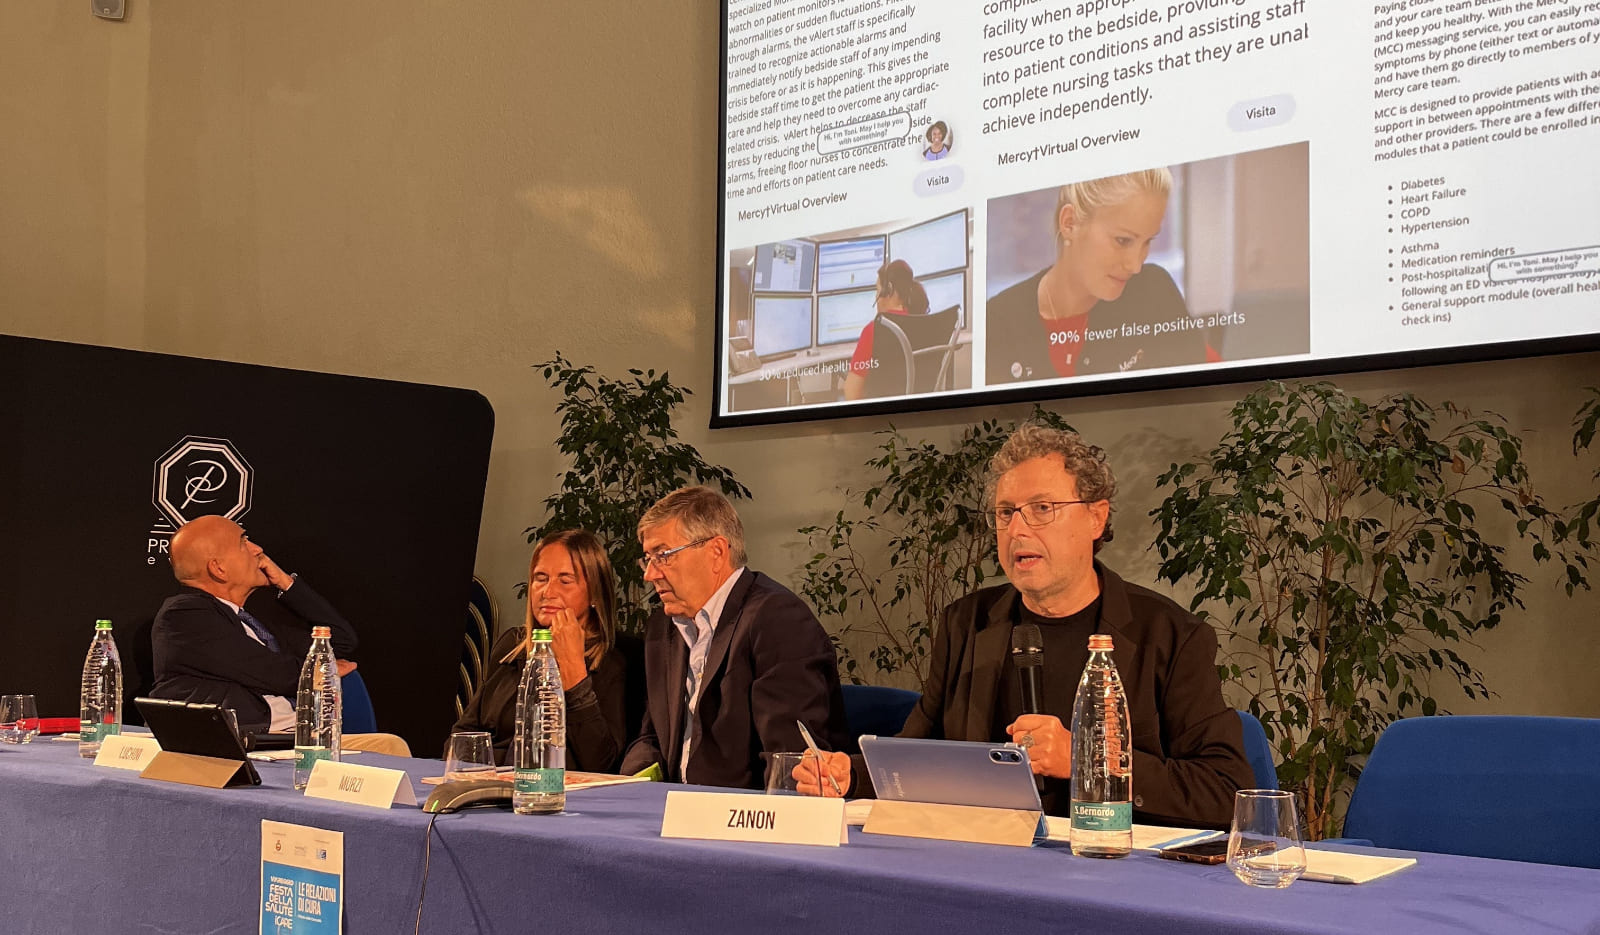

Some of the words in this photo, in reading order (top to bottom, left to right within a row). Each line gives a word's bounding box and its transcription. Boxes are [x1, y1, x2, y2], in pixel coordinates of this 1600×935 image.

[983, 17, 1027, 39] facility
[1031, 0, 1071, 26] when
[983, 38, 1044, 63] resource
[1049, 33, 1063, 46] to
[1068, 25, 1092, 42] the
[1097, 8, 1161, 35] bedside,
[1374, 42, 1403, 57] (MCC)
[1405, 31, 1459, 50] messaging
[1462, 23, 1501, 38] service,
[1504, 18, 1524, 32] you
[1527, 13, 1546, 24] can
[1549, 5, 1581, 19] easily
[728, 62, 756, 78] trained
[758, 62, 766, 71] to
[768, 51, 807, 68] recognize
[810, 37, 854, 57] actionable
[856, 29, 886, 44] alarms
[889, 21, 906, 36] and
[983, 70, 1009, 86] into
[1014, 55, 1064, 83] patient
[1069, 37, 1148, 66] conditions
[1153, 24, 1182, 47] and
[1188, 10, 1260, 38] assisting
[1266, 0, 1305, 20] staff
[728, 73, 777, 93] immediately
[778, 66, 802, 80] notify
[804, 57, 837, 74] bedside
[840, 50, 859, 65] staff
[861, 47, 870, 59] of
[872, 45, 889, 56] any
[891, 31, 940, 51] impending
[1374, 72, 1392, 84] and
[1395, 69, 1419, 80] have
[1421, 63, 1448, 75] them
[1451, 60, 1464, 71] go
[1466, 50, 1505, 65] directly
[1508, 48, 1520, 57] to
[1522, 37, 1576, 54] members
[1578, 31, 1591, 43] of
[728, 97, 747, 109] crisis
[749, 90, 775, 103] before
[777, 87, 786, 96] or
[789, 84, 798, 93] as
[800, 81, 805, 90] it
[808, 80, 814, 88] is
[816, 67, 864, 86] happening.
[867, 61, 885, 73] This
[887, 55, 910, 71] gives
[913, 51, 928, 62] the
[982, 85, 1048, 110] complete
[1052, 71, 1108, 94] nursing
[1113, 60, 1152, 80] tasks
[1158, 51, 1190, 71] that
[1194, 43, 1232, 63] they
[1236, 36, 1263, 54] are
[728, 108, 758, 123] bedside
[760, 101, 779, 116] staff
[780, 99, 798, 111] time
[801, 96, 809, 105] to
[811, 92, 825, 105] get
[827, 88, 841, 99] the
[843, 79, 874, 97] patient
[877, 76, 891, 87] the
[894, 62, 948, 84] appropriate
[1374, 86, 1404, 98] Mercy
[1406, 82, 1428, 92] care
[1431, 76, 1459, 87] team.
[1374, 106, 1396, 119] MCC
[1399, 106, 1407, 114] is
[1409, 95, 1455, 112] designed
[1458, 94, 1469, 103] to
[1472, 85, 1512, 103] provide
[1516, 77, 1560, 95] patients
[1563, 71, 1587, 83] with
[727, 128, 744, 139] care
[746, 121, 761, 134] and
[763, 118, 781, 130] help
[783, 114, 801, 125] they
[803, 106, 824, 120] need
[826, 106, 835, 115] to
[837, 95, 881, 112] overcome
[883, 90, 900, 102] any
[902, 82, 938, 97] cardiac-
[982, 112, 1035, 134] achieve
[1039, 85, 1152, 122] independently.
[1245, 106, 1275, 119] Visita
[1374, 135, 1392, 147] and
[1395, 132, 1422, 143] other
[1425, 122, 1476, 140] providers.
[1479, 116, 1511, 128] There
[1513, 112, 1531, 122] are
[1534, 111, 1541, 119] a
[1544, 106, 1564, 117] few
[1080, 128, 1140, 148] Overview
[1374, 147, 1417, 161] modules
[1419, 143, 1440, 153] that
[1452, 134, 1488, 150] patient
[1491, 127, 1521, 141] could
[1524, 126, 1538, 135] be
[1541, 115, 1587, 133] enrolled
[727, 188, 744, 198] time
[746, 183, 761, 194] and
[763, 178, 790, 191] efforts
[792, 176, 803, 185] on
[805, 168, 835, 185] patient
[837, 165, 856, 175] care
[858, 157, 887, 171] needs.
[926, 175, 949, 186] Visita
[1401, 176, 1444, 190] Diabetes
[801, 192, 847, 208] Overview
[1401, 193, 1428, 204] Heart
[1431, 188, 1466, 200] Failure
[1400, 206, 1430, 219] COPD
[1401, 217, 1469, 234] Hypertension
[1400, 242, 1439, 254] Asthma
[1401, 254, 1457, 268] Medication
[1460, 247, 1515, 260] reminders
[1401, 298, 1440, 311] General
[1444, 294, 1484, 307] support
[1488, 288, 1529, 301] module
[1531, 283, 1573, 298] (overall
[1049, 330, 1080, 345] 90%
[1084, 326, 1118, 341] fewer
[1121, 322, 1150, 337] false
[1154, 316, 1204, 336] positive
[1208, 312, 1246, 328] alerts
[1401, 314, 1430, 325] check
[1432, 312, 1451, 322] ins)
[783, 363, 820, 379] reduced
[822, 360, 852, 375] health
[854, 358, 879, 371] costs
[338, 774, 365, 793] MURZI
[727, 808, 776, 830] ZANON
[269, 884, 294, 897] FESTA
[269, 893, 293, 907] DELLA
[298, 882, 306, 897] LE
[305, 882, 337, 903] RELAZIONI
[265, 902, 294, 917] SALUTE
[297, 897, 305, 912] DI
[305, 899, 321, 916] CURA
